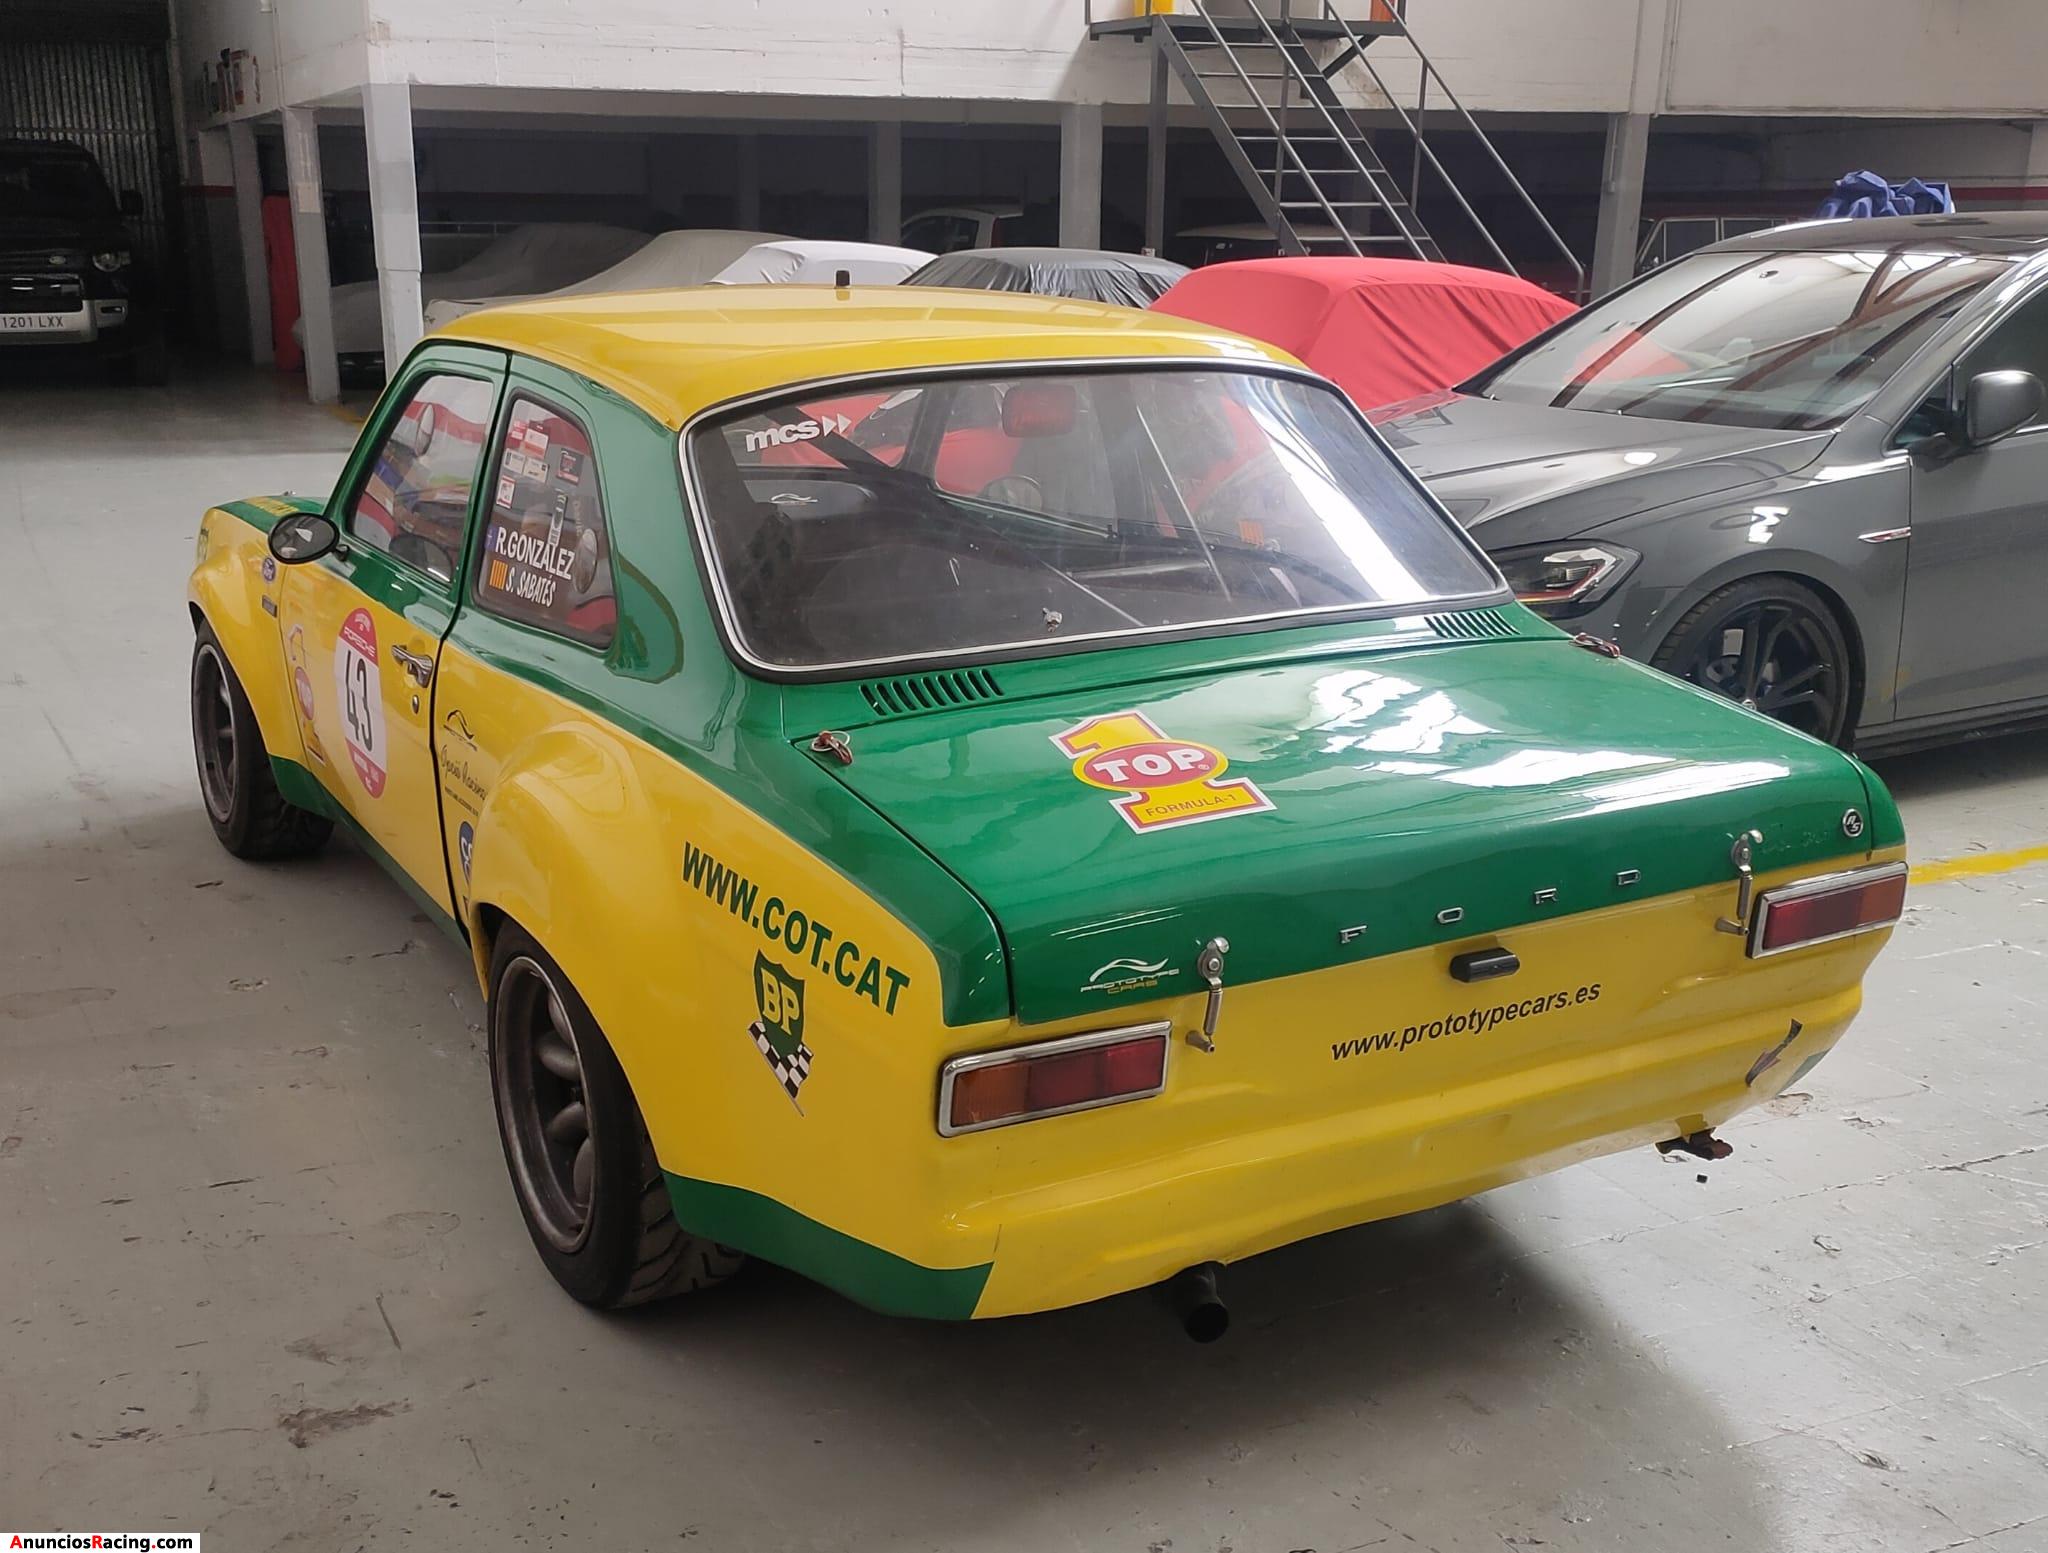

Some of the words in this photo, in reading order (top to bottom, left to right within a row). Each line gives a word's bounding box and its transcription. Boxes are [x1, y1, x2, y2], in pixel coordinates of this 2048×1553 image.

[2, 316, 34, 329] 1201
[38, 316, 65, 329] LXX
[745, 419, 821, 453] mcs
[515, 574, 557, 608] SABATÉS
[345, 649, 373, 753] 43
[1092, 747, 1206, 783] TOP
[1145, 793, 1237, 818] FORMULA-1
[682, 840, 911, 1017] WWW.COT.CAT
[1339, 868, 1642, 945] FORD
[760, 966, 800, 1037] BP
[1330, 982, 1602, 1061] www.prototypecars.es
